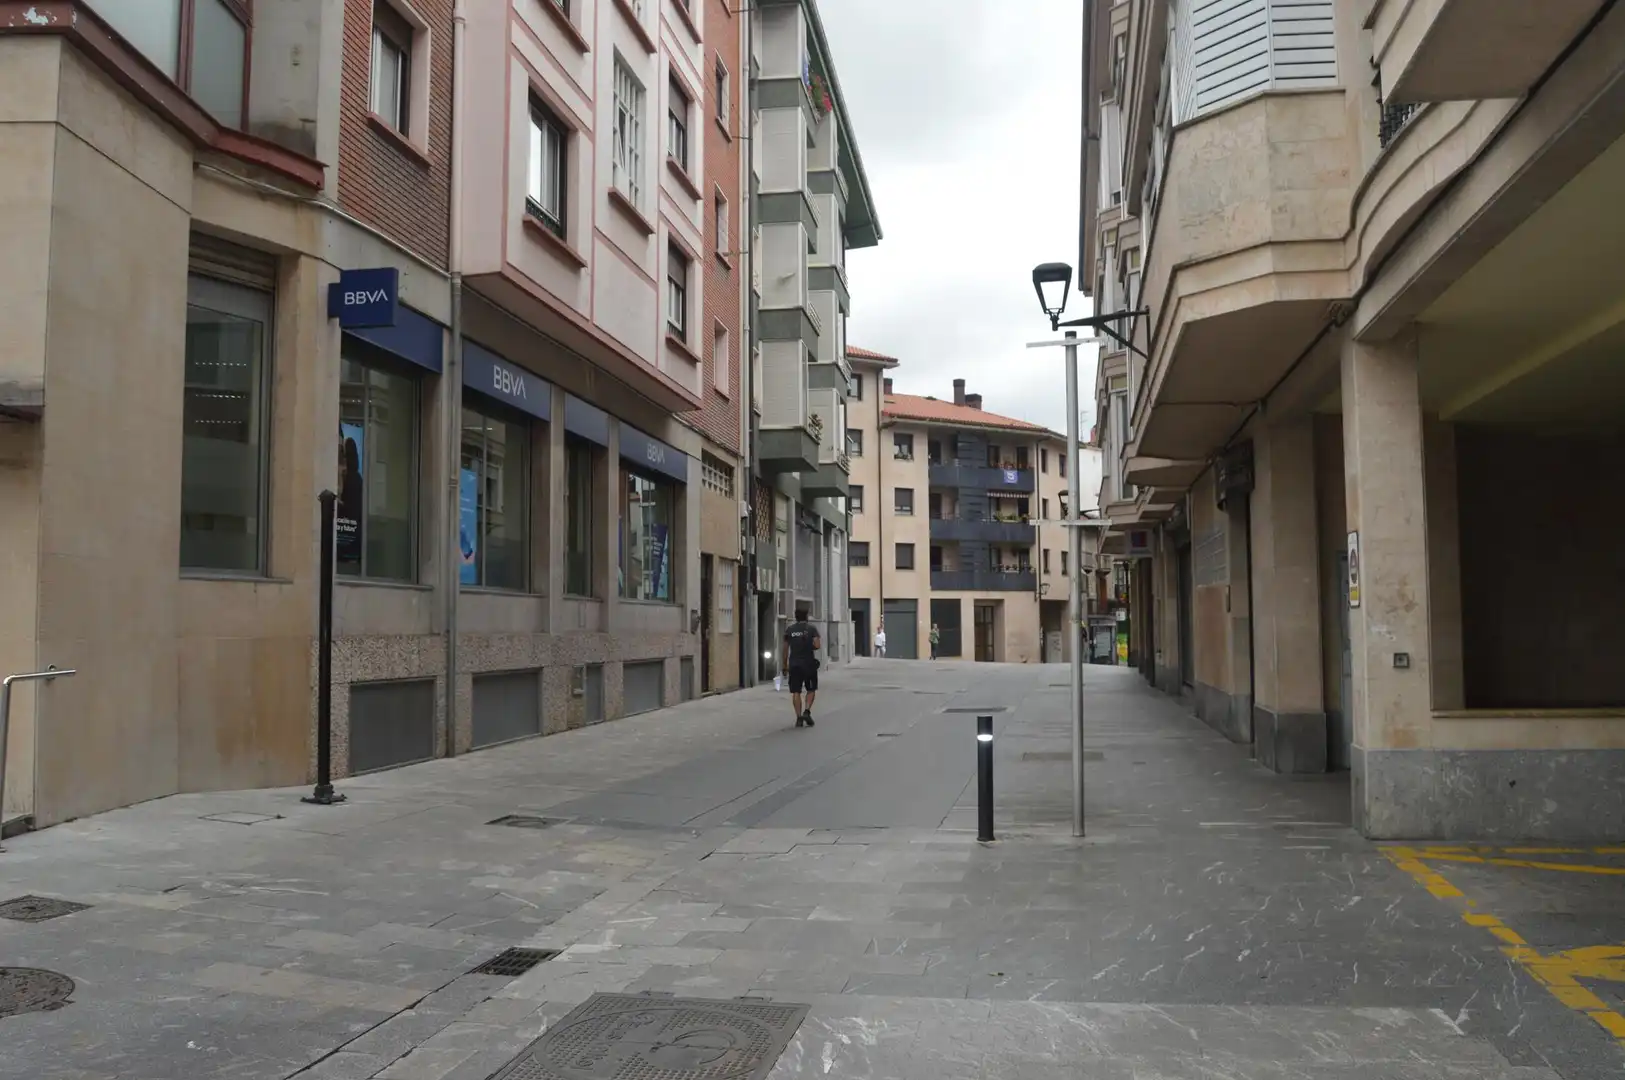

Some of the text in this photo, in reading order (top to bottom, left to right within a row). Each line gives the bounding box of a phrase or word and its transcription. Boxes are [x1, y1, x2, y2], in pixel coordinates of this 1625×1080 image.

[344, 289, 388, 305] BBVA
[493, 364, 527, 399] BBVA
[646, 442, 666, 465] BBVA
